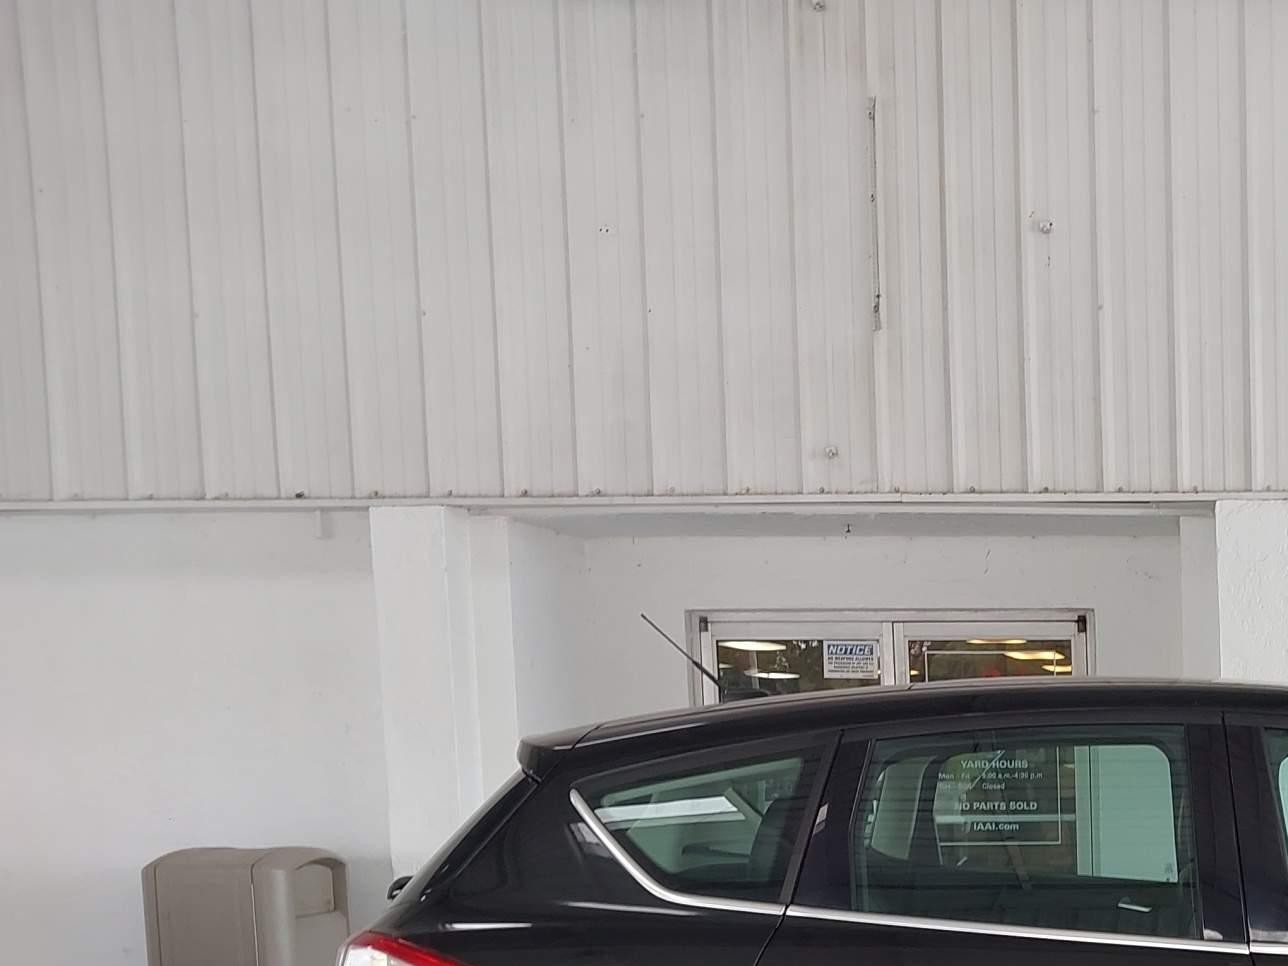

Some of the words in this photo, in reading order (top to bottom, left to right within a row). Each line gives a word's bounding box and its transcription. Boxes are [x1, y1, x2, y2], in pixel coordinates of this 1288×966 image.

[828, 644, 872, 655] NOTICE
[961, 760, 989, 769] YARD
[992, 760, 1028, 769] HOURS
[982, 782, 1005, 790] Closed
[973, 801, 1007, 811] PARTS
[1010, 801, 1038, 811] SOLD
[973, 822, 1020, 831] IAAI.com
